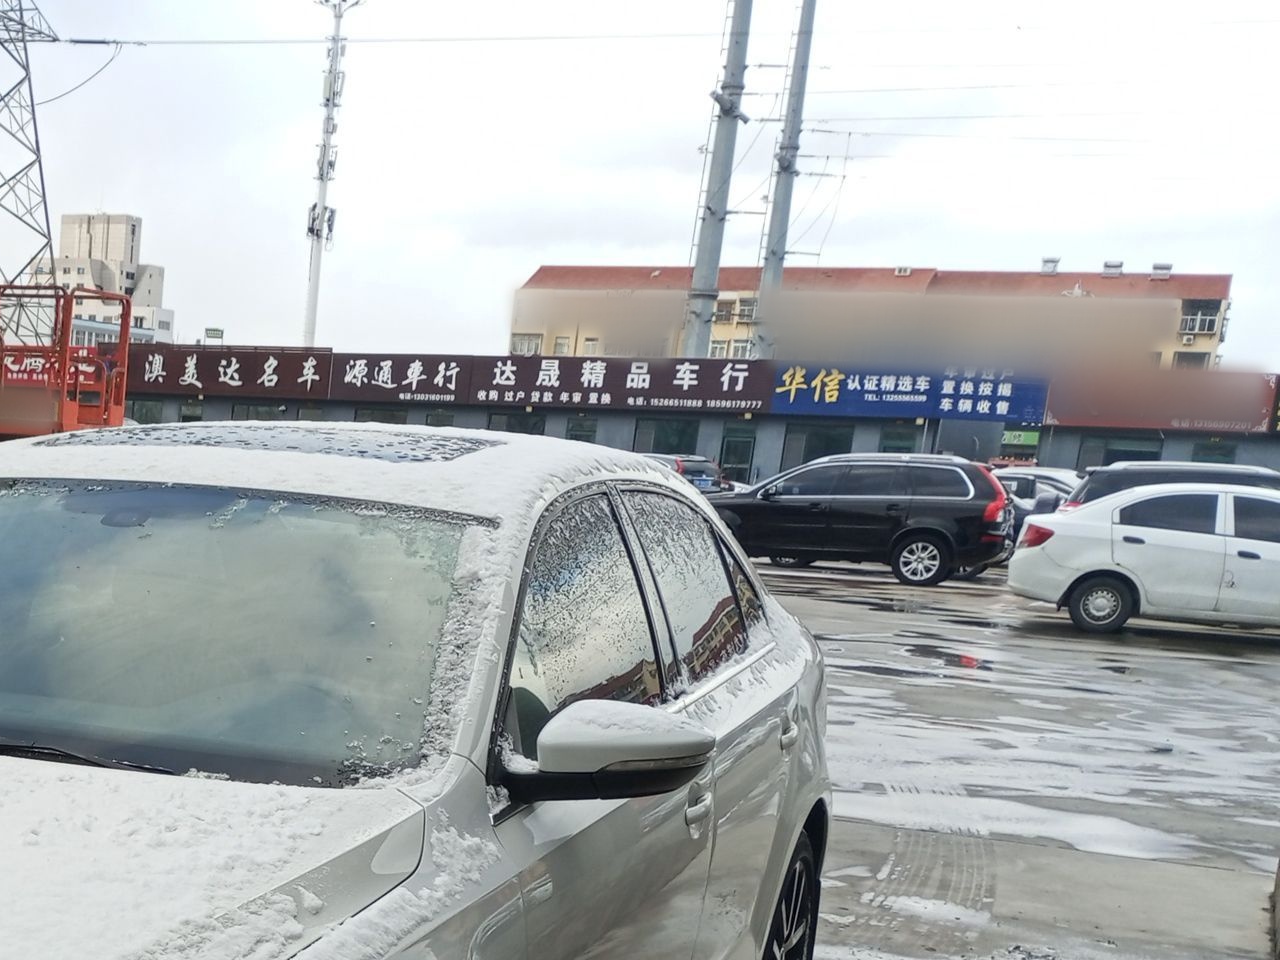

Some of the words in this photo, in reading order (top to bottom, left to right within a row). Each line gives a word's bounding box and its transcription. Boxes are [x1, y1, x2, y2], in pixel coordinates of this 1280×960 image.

[144, 353, 320, 392] 澳美达名车
[492, 360, 749, 392] 达晟精品车行
[775, 365, 846, 404] 华信
[847, 374, 931, 392] 认证精选车
[941, 380, 1013, 397] 置换按揭
